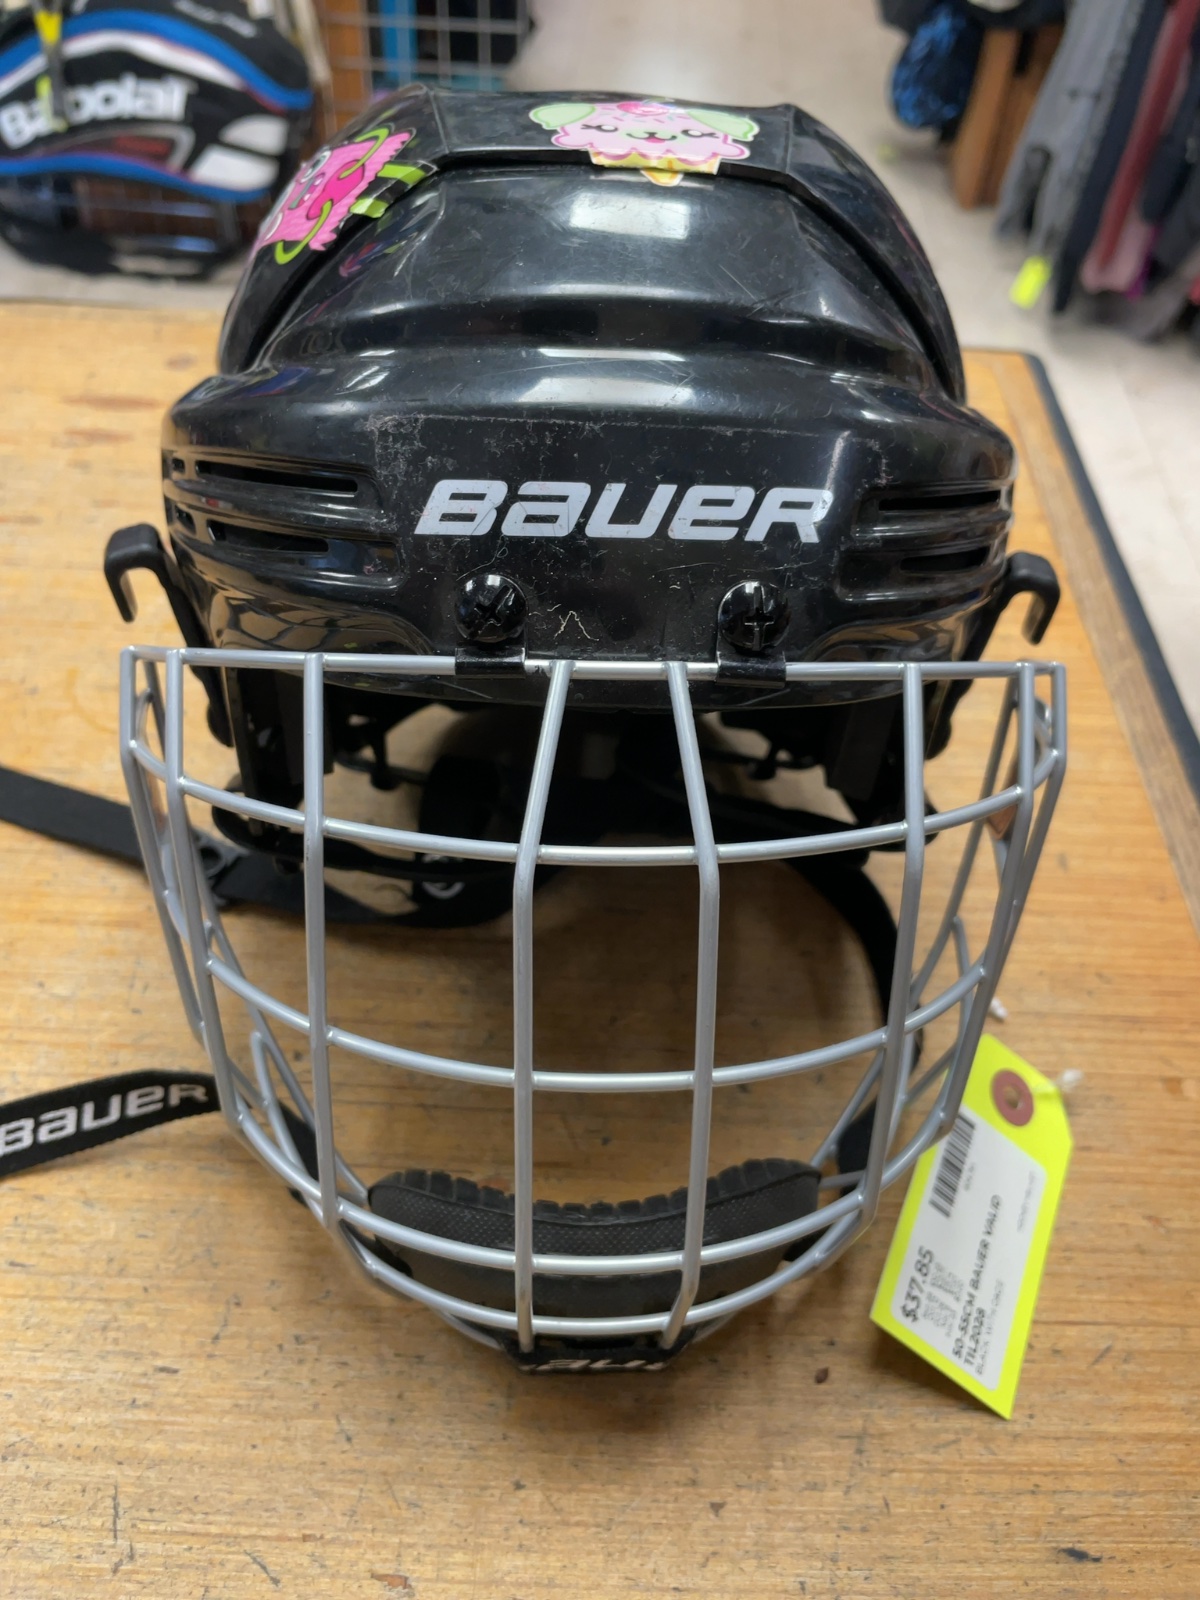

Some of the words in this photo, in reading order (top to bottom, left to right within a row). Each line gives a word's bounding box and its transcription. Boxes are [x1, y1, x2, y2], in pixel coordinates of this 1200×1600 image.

[900, 1244, 934, 1324] $37.85
[968, 1239, 989, 1292] BAUER
[983, 1194, 1001, 1238] VALID
